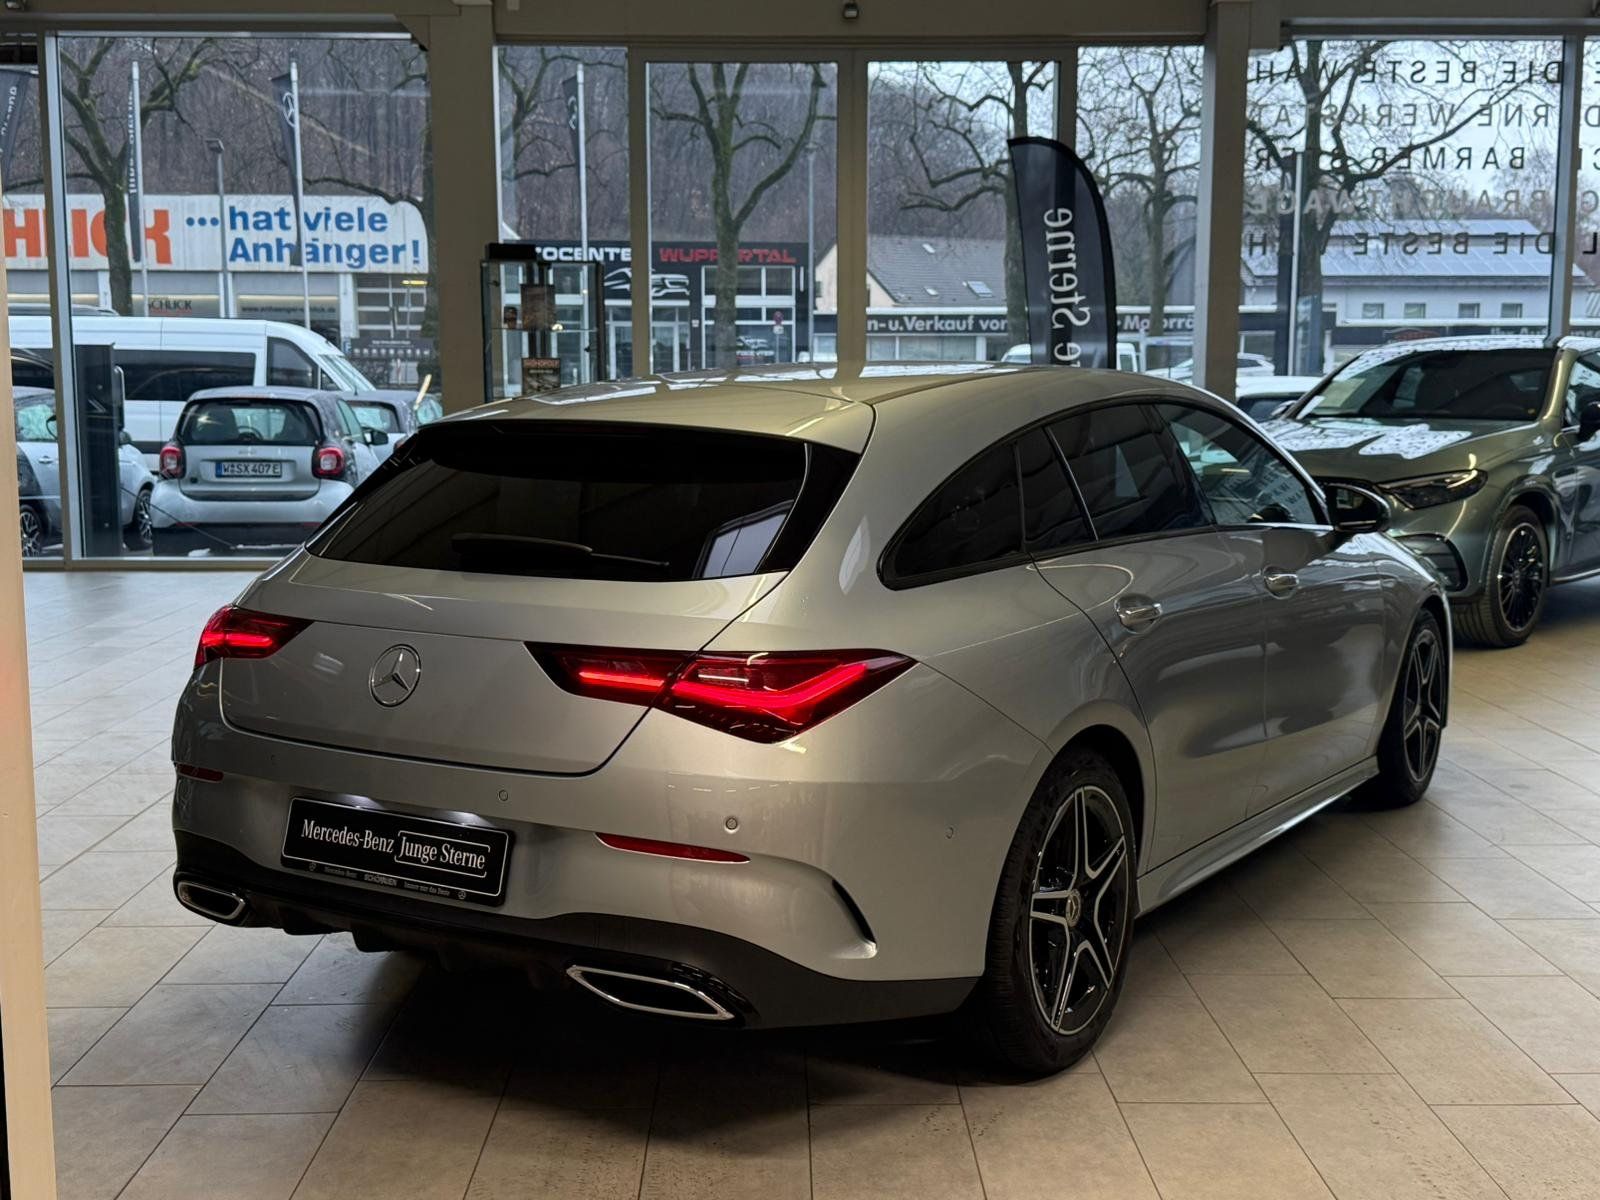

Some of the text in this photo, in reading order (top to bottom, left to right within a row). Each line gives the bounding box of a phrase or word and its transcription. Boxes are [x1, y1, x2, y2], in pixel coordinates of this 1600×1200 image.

[229, 206, 292, 232] hat
[304, 207, 389, 232] viele
[535, 246, 632, 262] OCENTE
[301, 819, 486, 870] Mercedes-Benz Junge Sterne
